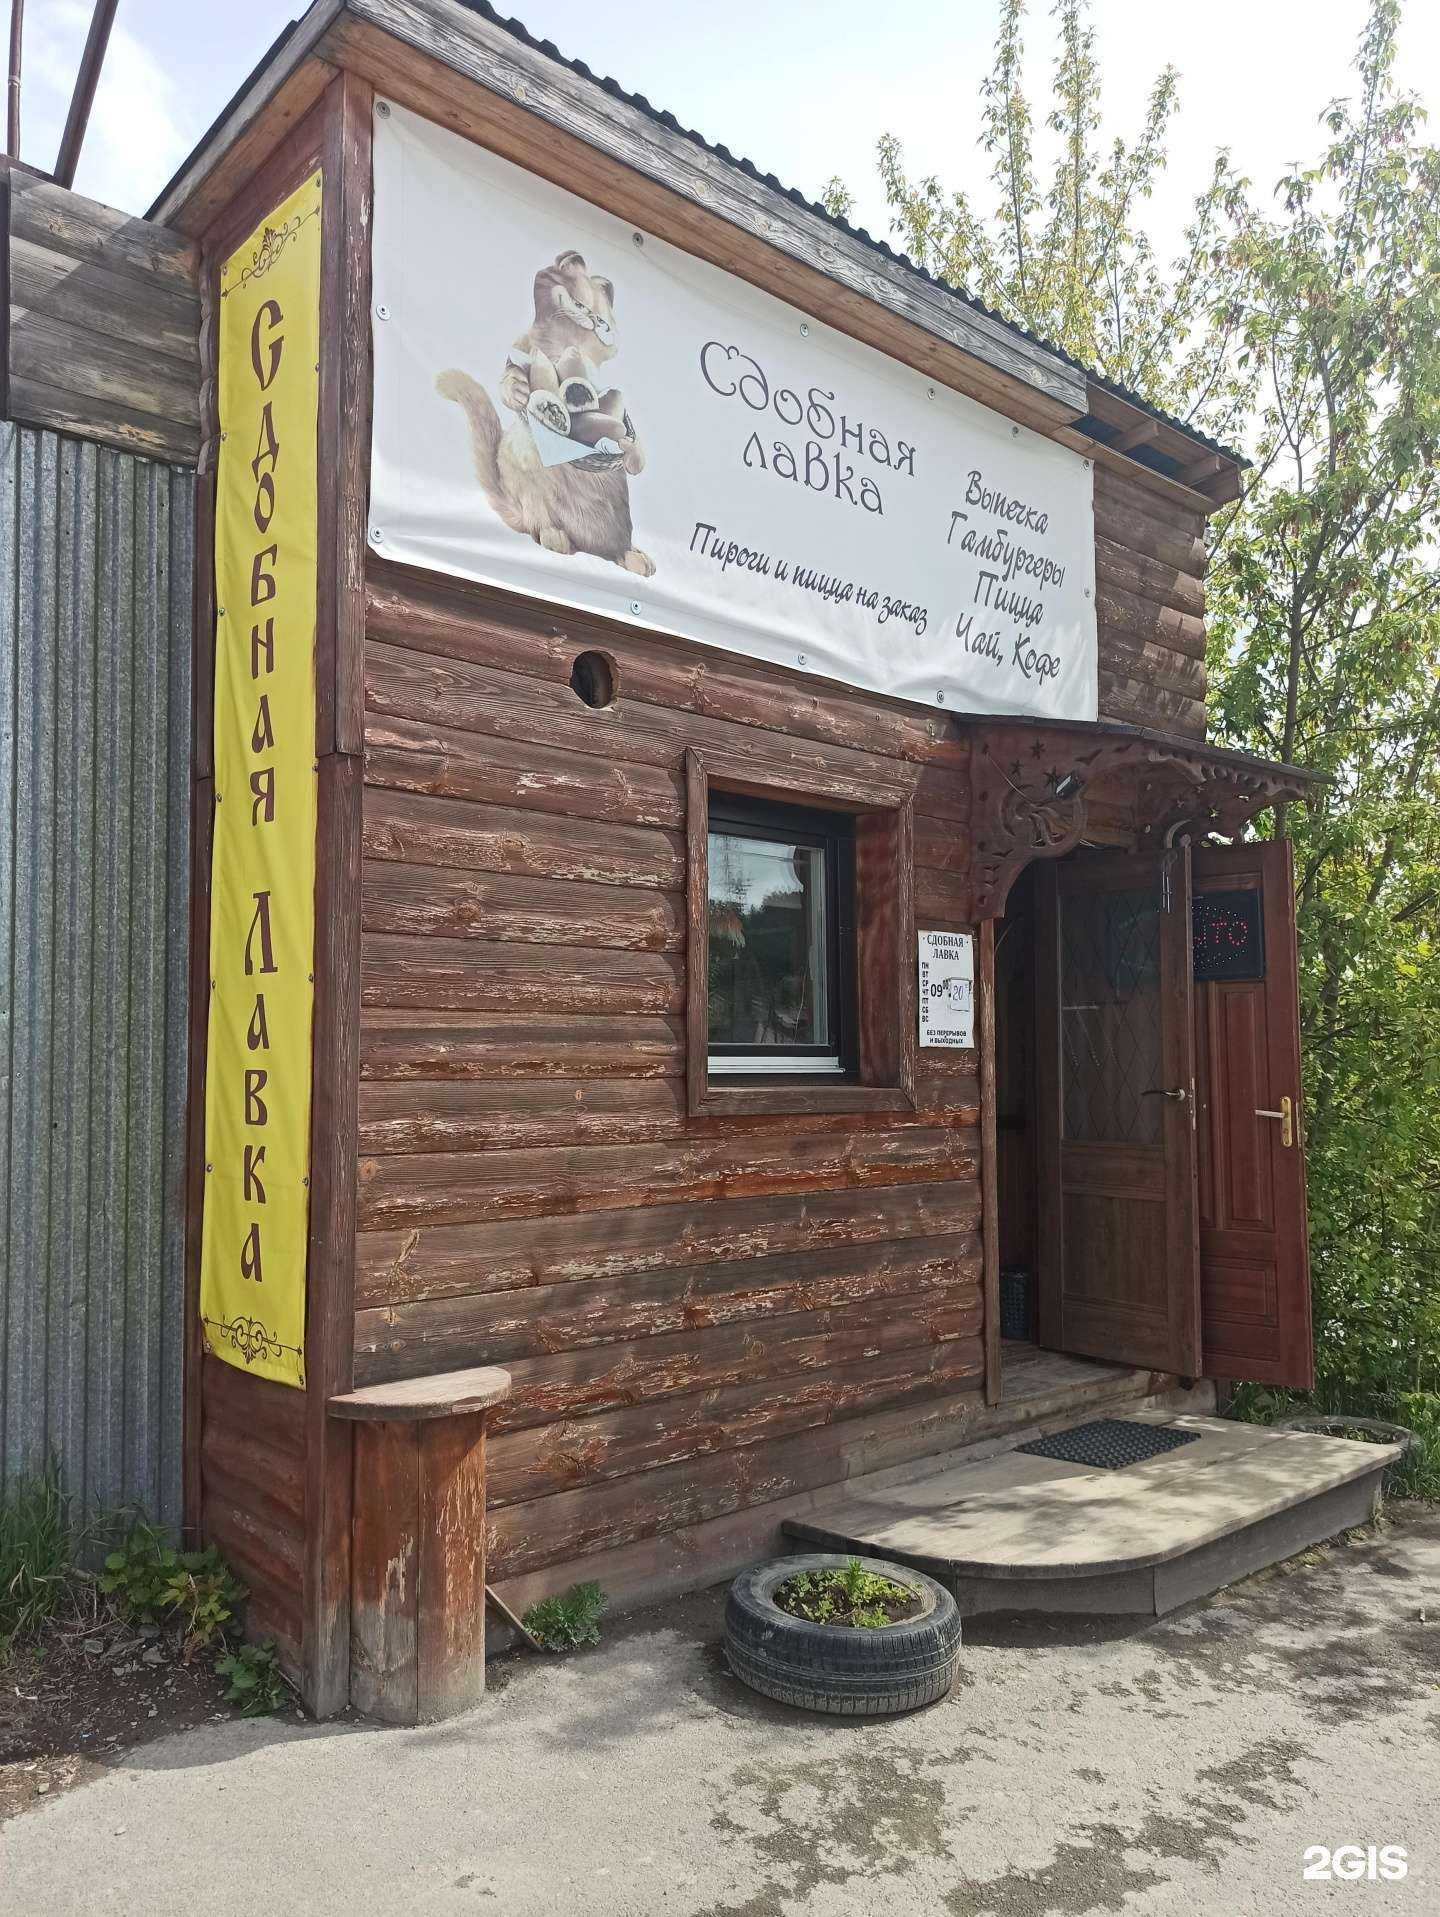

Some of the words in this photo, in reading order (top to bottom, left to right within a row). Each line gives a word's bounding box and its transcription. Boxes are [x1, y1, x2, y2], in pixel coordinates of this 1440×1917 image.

[700, 341, 917, 477] Сдобная
[965, 470, 1049, 535] Выпечка
[689, 522, 771, 571] Пироги
[774, 560, 788, 581] и
[793, 565, 854, 603] пицца
[856, 585, 878, 610] на
[877, 596, 928, 636] заказ
[947, 511, 1066, 591] Гамбургеры
[974, 570, 1044, 627] Пицца
[956, 612, 1004, 667] Чай,
[1012, 633, 1061, 685] Кофе
[927, 934, 964, 947] СДОБНАЯ
[932, 948, 960, 961] ЛАВКА
[937, 1029, 967, 1037] ПЕРЕРЫВОВ
